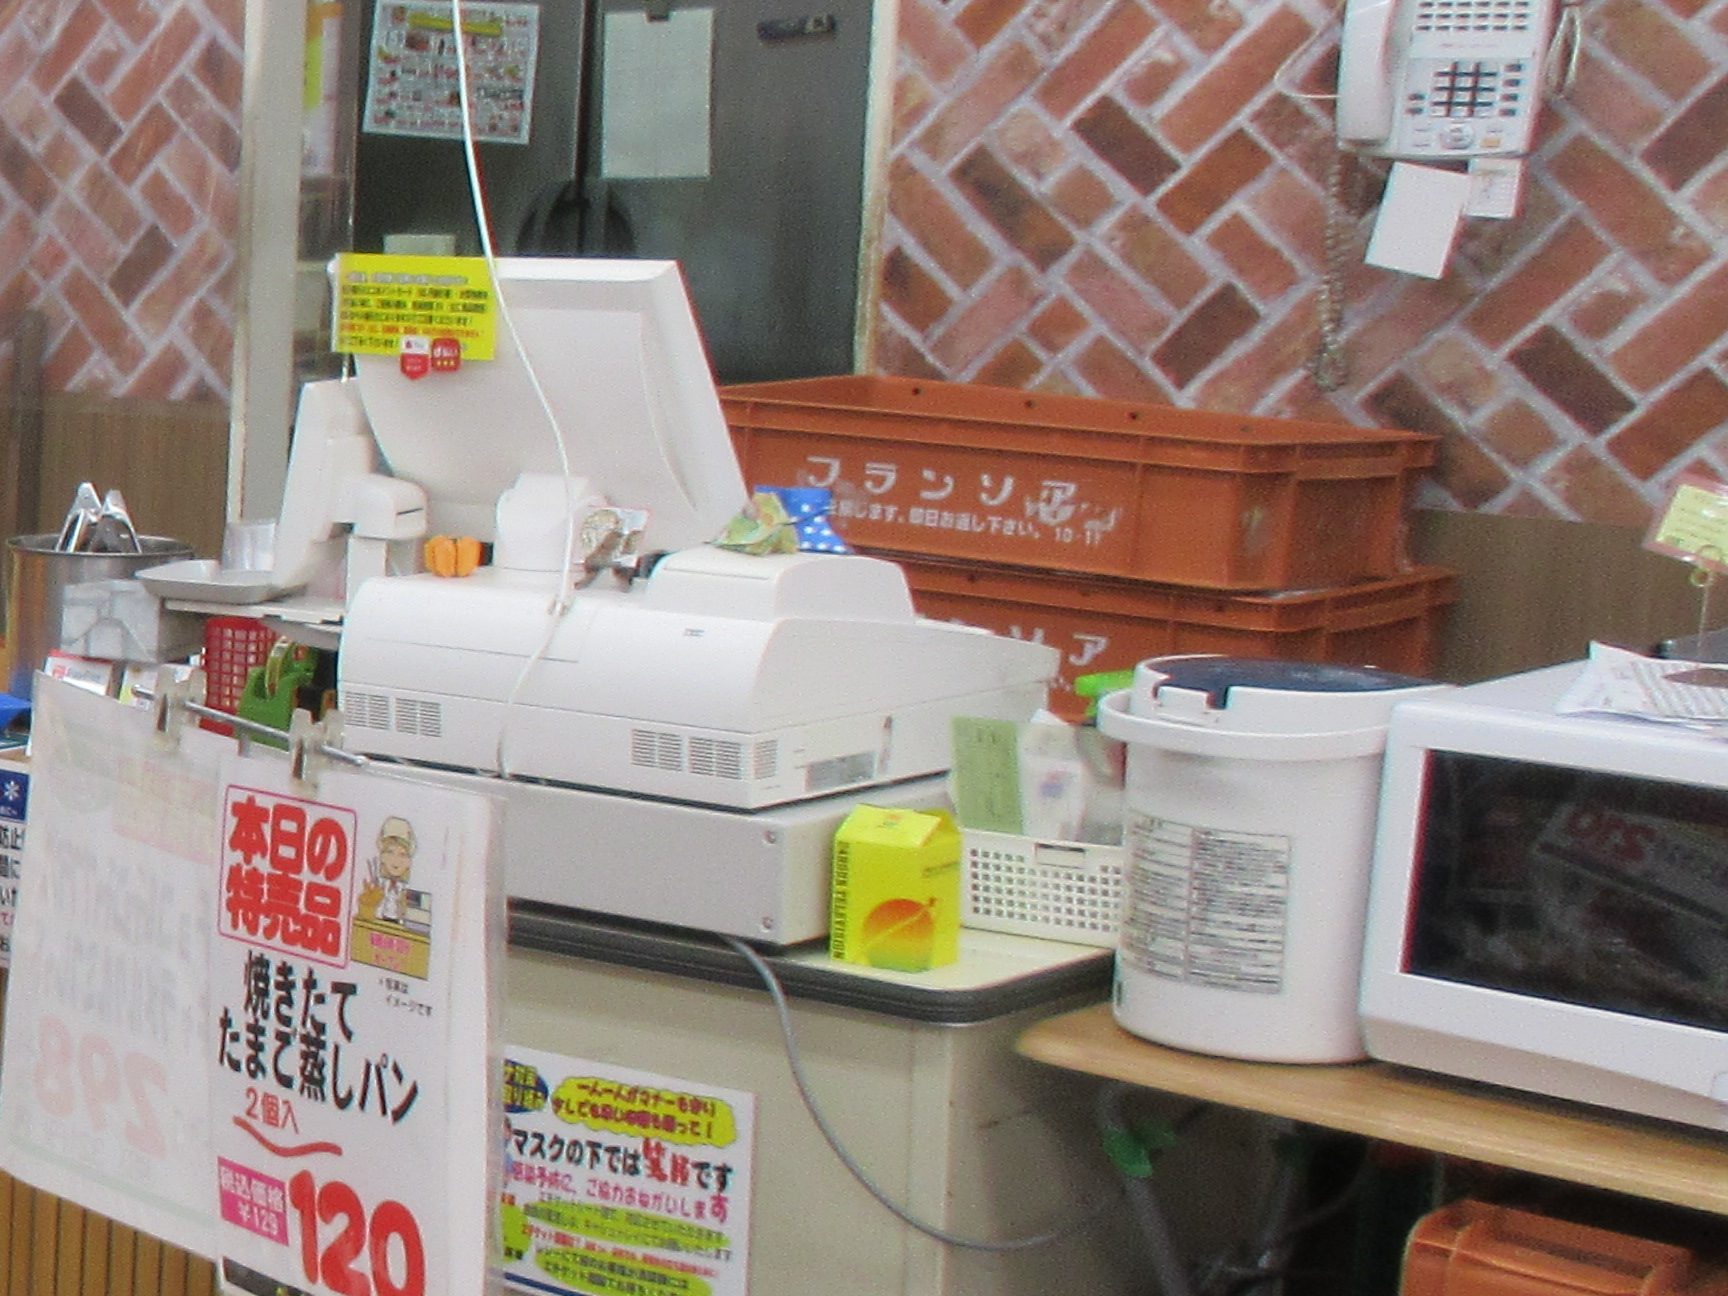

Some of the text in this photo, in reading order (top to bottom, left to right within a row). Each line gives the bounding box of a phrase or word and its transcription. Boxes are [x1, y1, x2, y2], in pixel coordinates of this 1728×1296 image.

[807, 456, 1077, 524] フランソア
[228, 795, 348, 877] 本日の
[224, 866, 345, 960] 特売品
[244, 950, 360, 1042] 焼きたて
[218, 1008, 422, 1124] たまご蒸しパン
